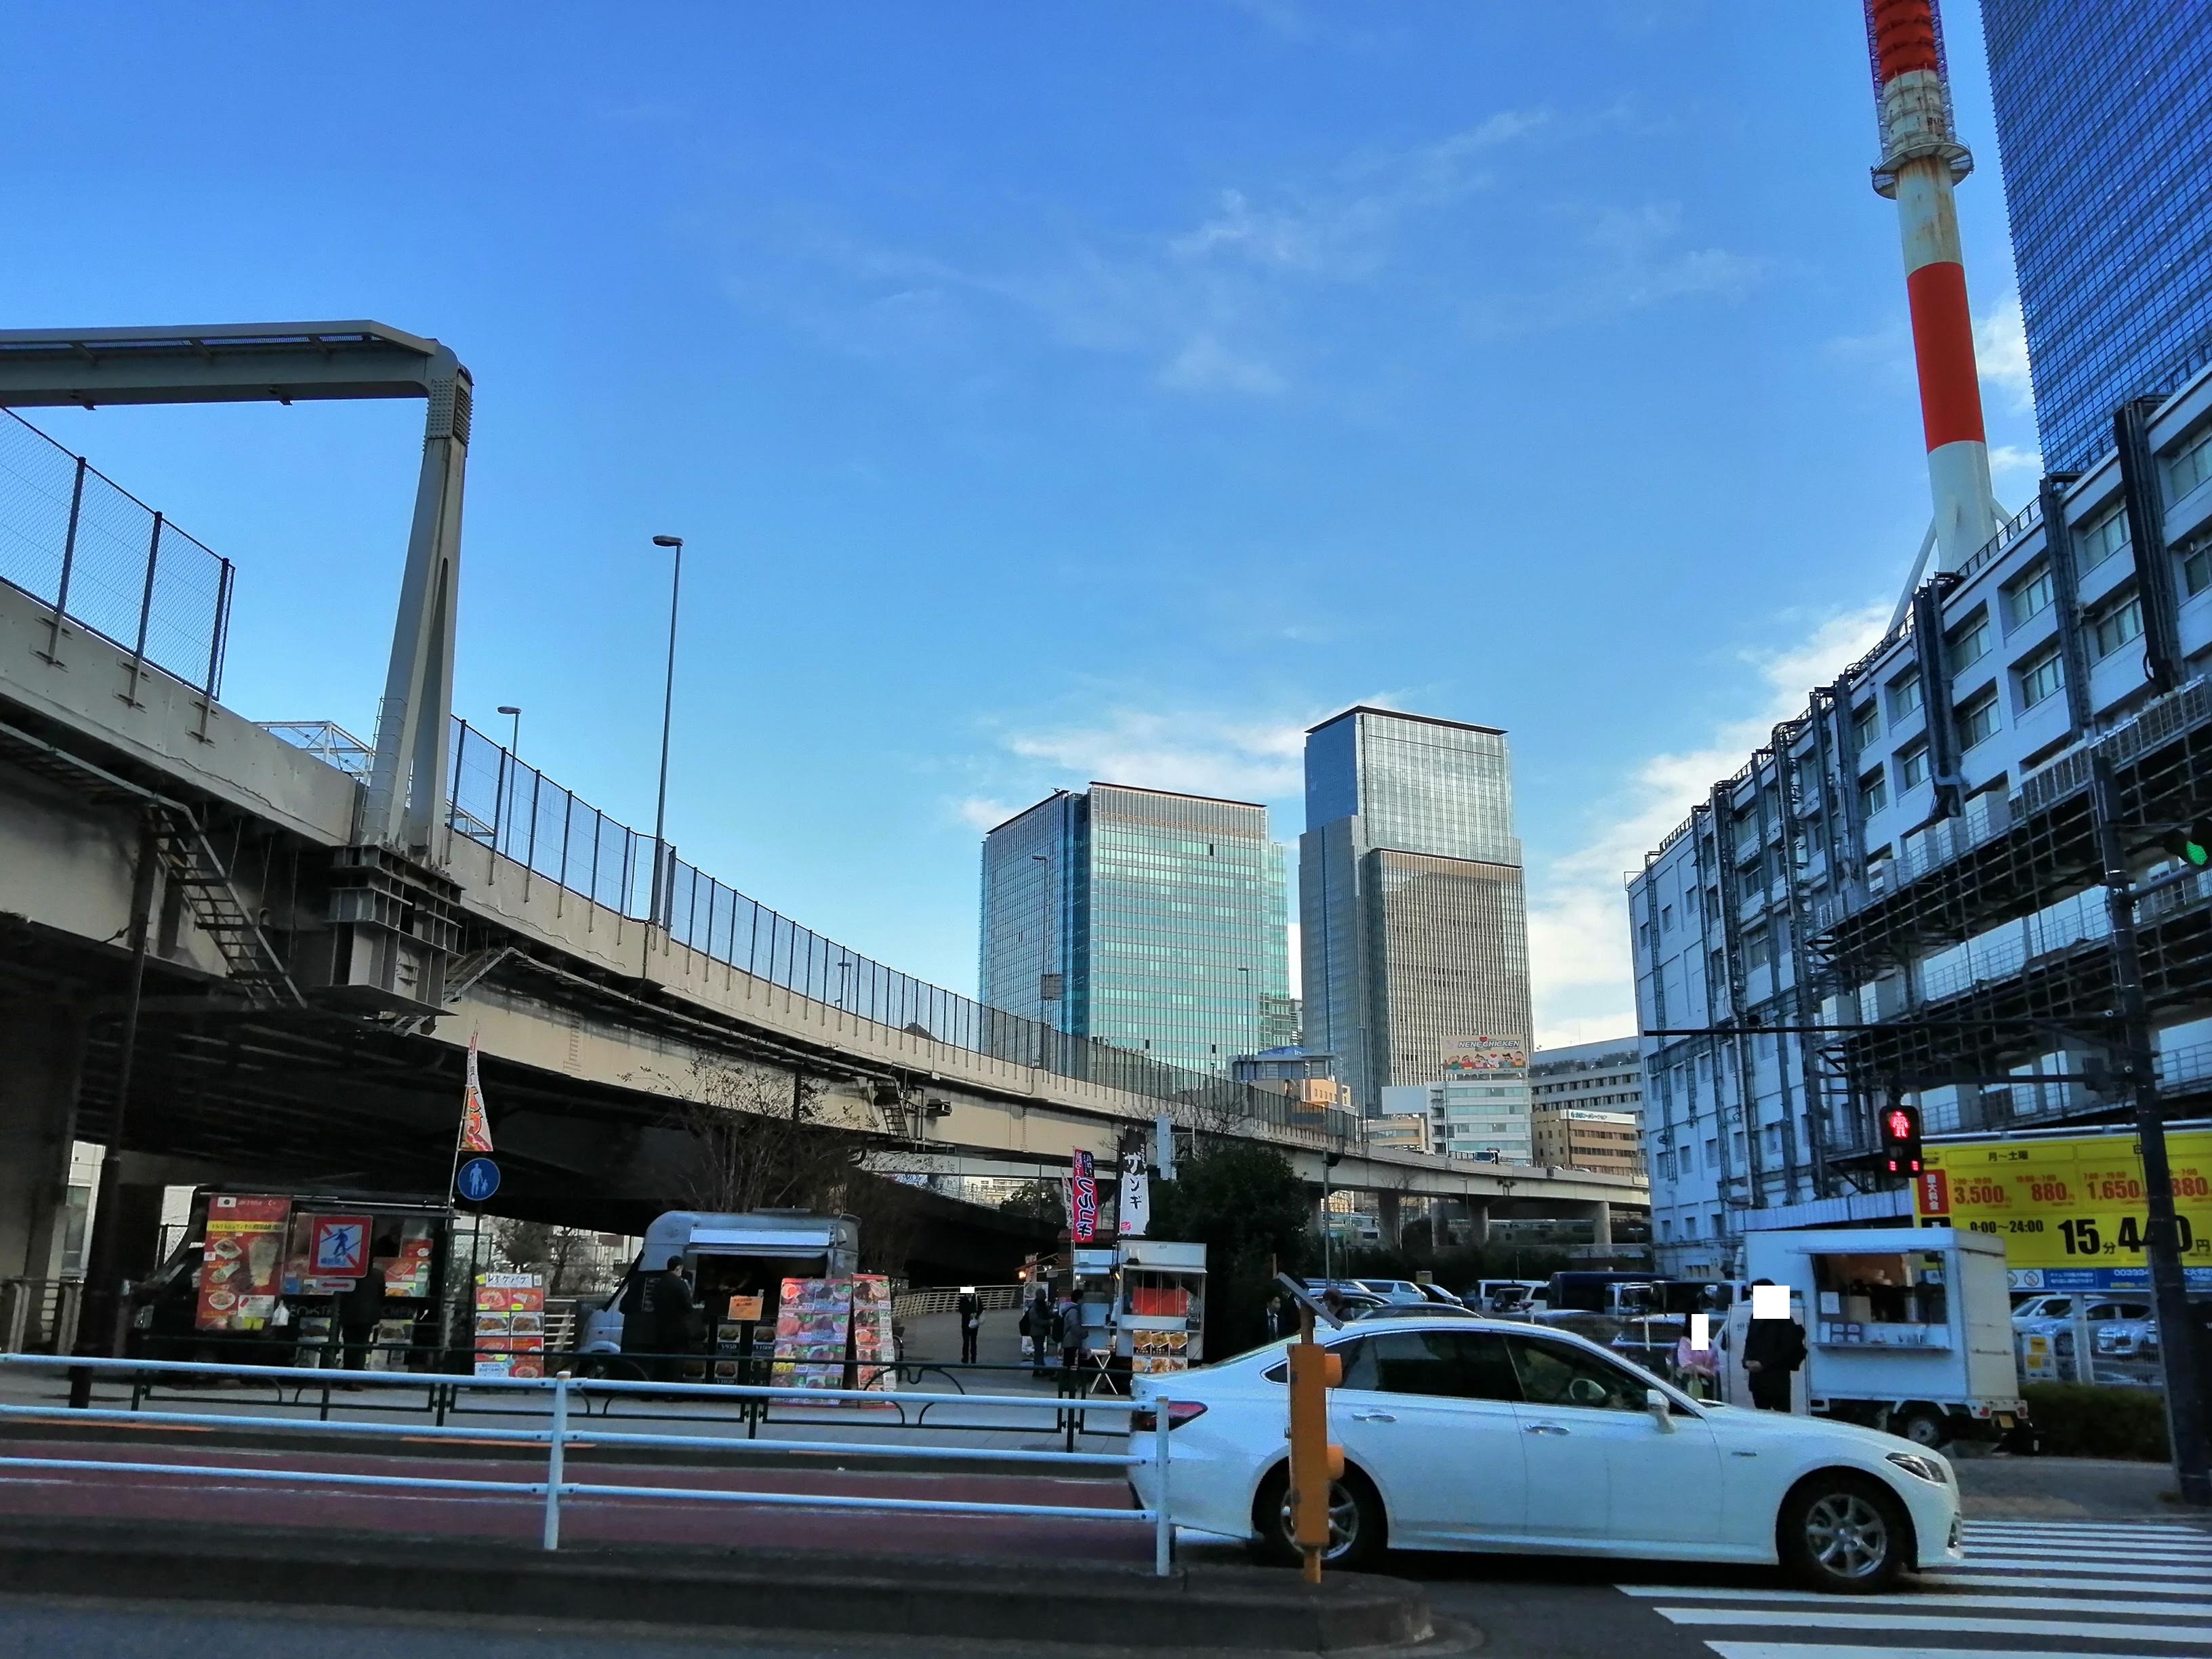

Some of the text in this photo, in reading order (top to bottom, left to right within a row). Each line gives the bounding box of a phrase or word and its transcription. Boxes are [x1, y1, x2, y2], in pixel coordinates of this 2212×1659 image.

[1483, 1040, 1520, 1048] CHICKEN
[1122, 1151, 1143, 1210] ザンギ
[2171, 1176, 2212, 1197] 880
